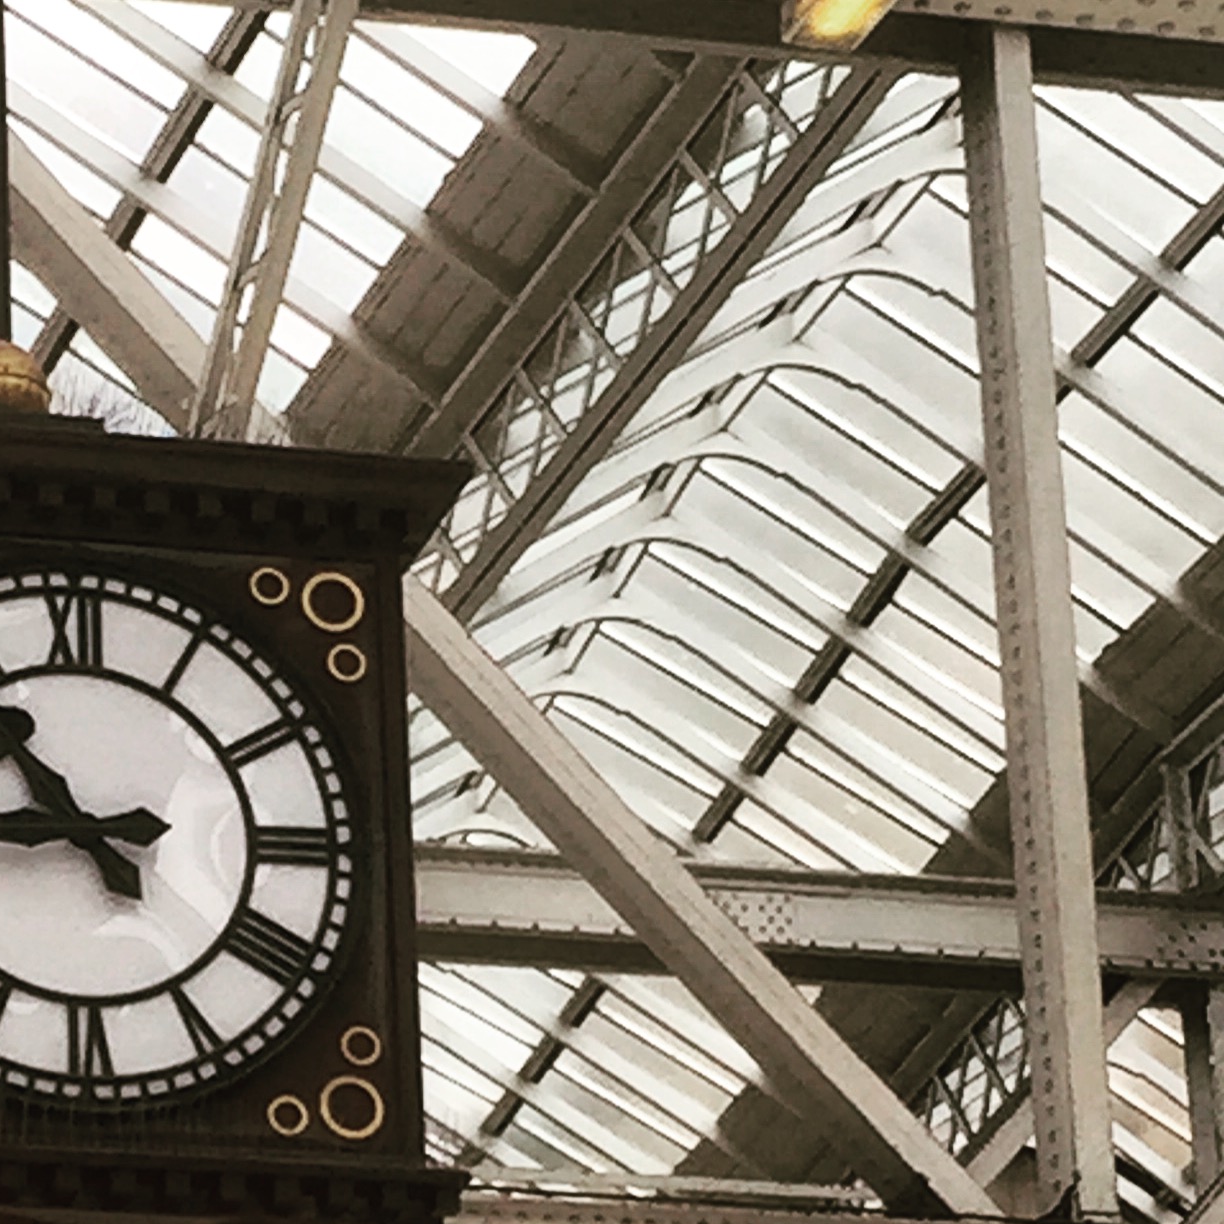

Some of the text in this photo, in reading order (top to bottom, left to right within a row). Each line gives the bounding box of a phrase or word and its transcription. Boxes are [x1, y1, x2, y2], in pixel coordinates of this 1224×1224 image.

[43, 595, 103, 668] XII
[162, 632, 202, 697] I
[224, 716, 299, 768] II
[253, 824, 327, 866] III
[224, 906, 315, 987] IIII
[67, 1001, 115, 1077] VI
[169, 985, 227, 1053] V
